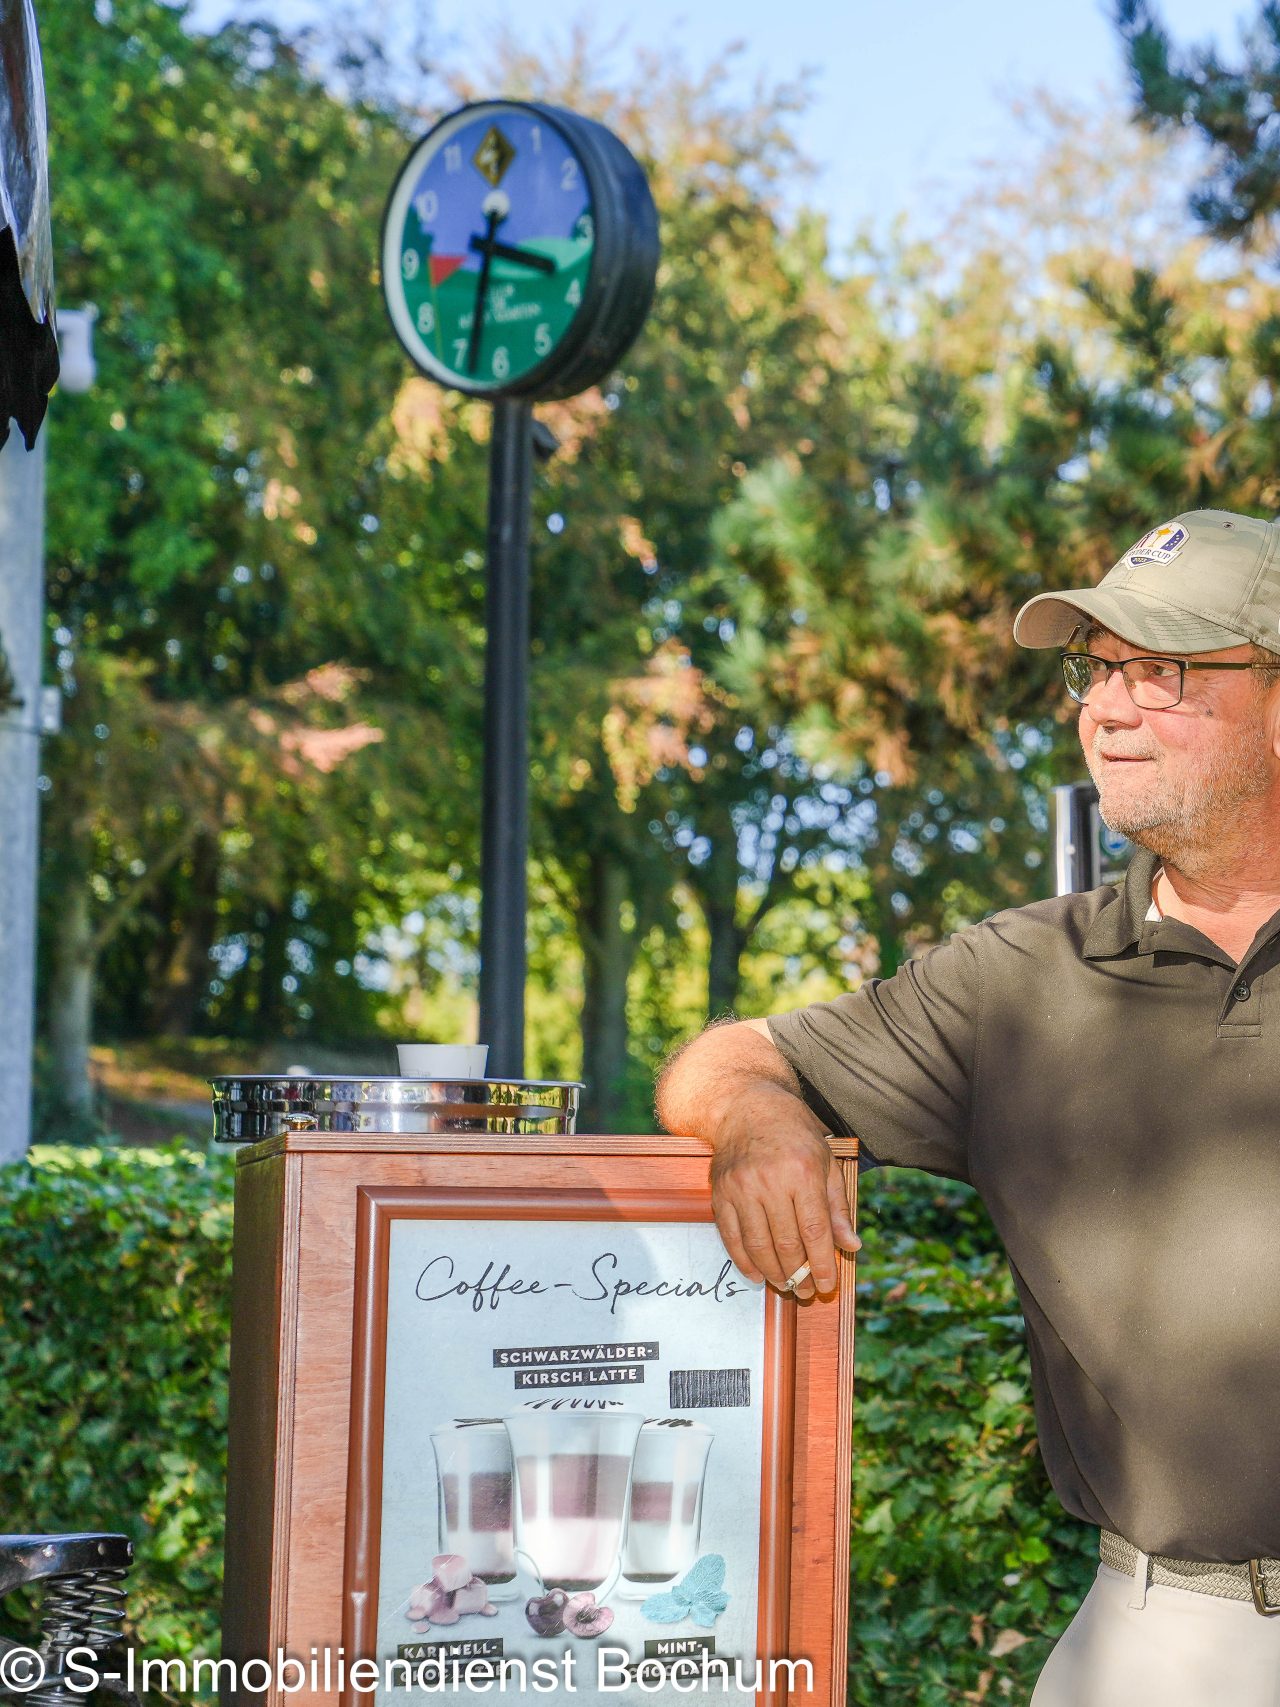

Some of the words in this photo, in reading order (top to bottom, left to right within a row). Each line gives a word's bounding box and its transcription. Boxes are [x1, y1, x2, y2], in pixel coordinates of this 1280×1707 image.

[560, 157, 578, 190] 2
[575, 214, 594, 246] 3
[402, 247, 419, 280] 9
[564, 278, 581, 306] 4
[417, 302, 435, 334] 8
[452, 338, 469, 370] 7
[534, 322, 552, 357] 5
[492, 346, 509, 379] 6
[1152, 550, 1171, 559] CUP
[500, 1345, 653, 1364] SCHWARZWÄLDER-
[522, 1371, 583, 1385] KIRSCH
[589, 1368, 637, 1382] LATTE
[657, 1640, 703, 1655] MINT-
